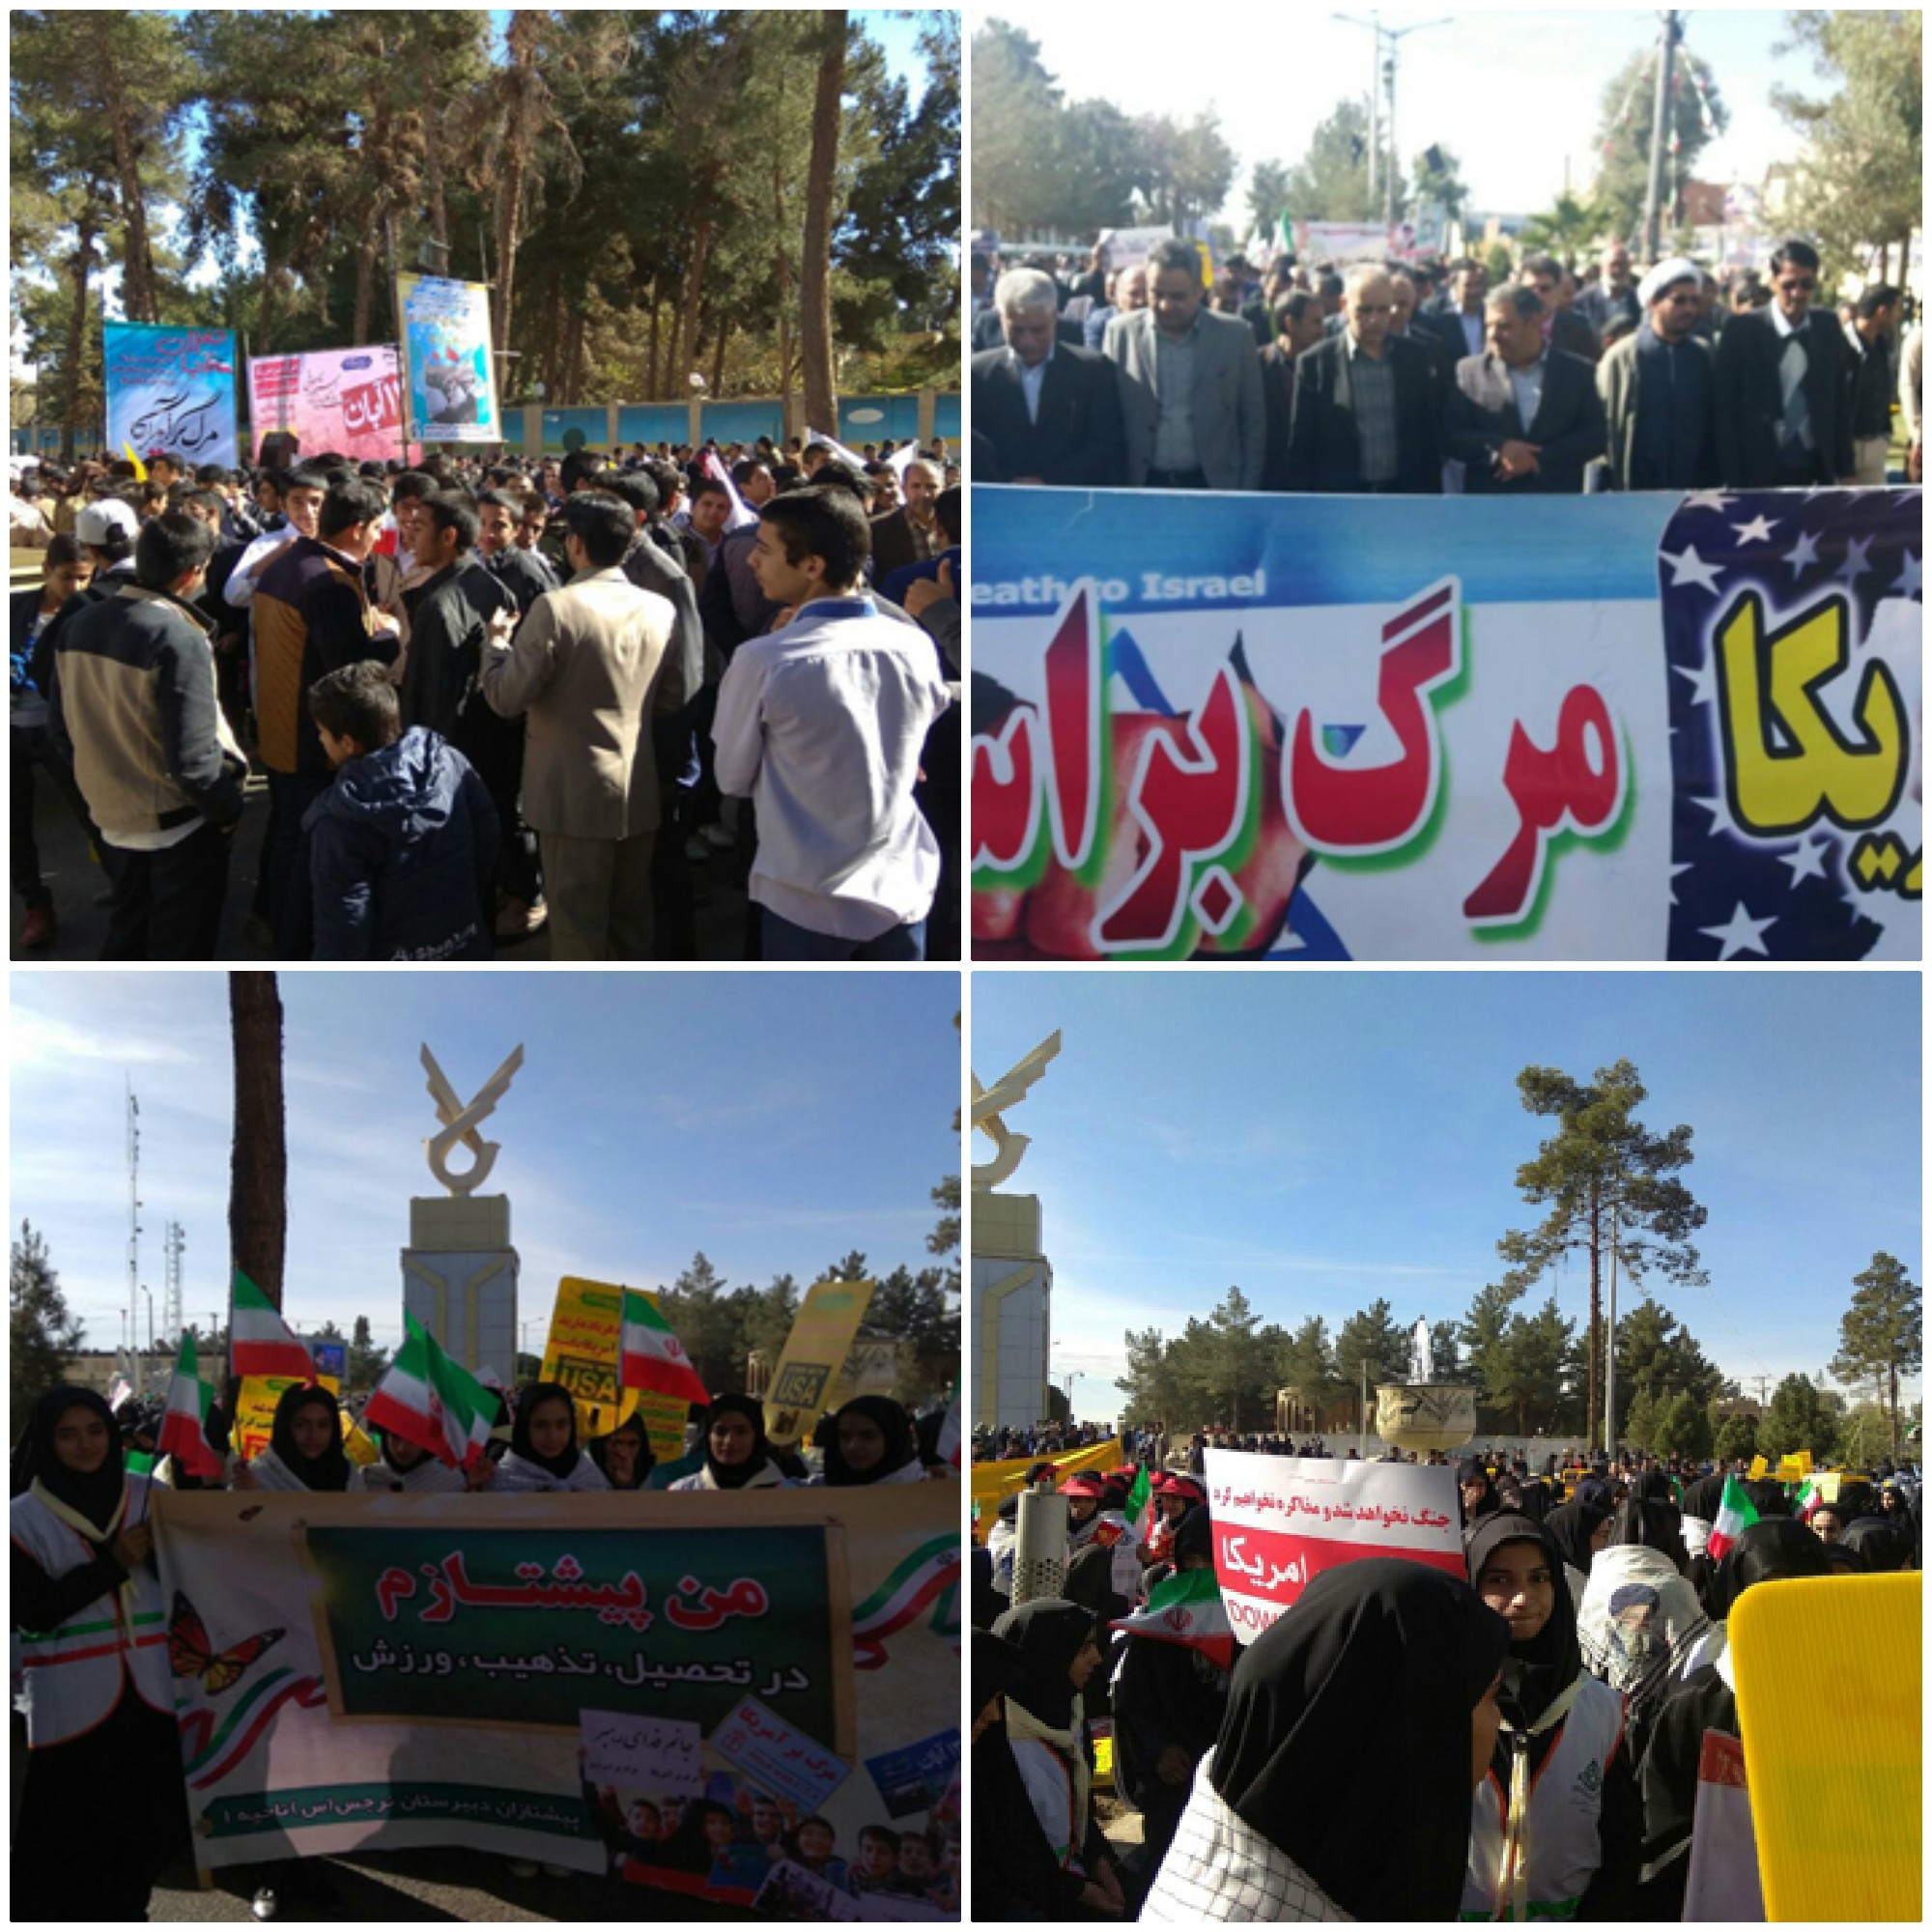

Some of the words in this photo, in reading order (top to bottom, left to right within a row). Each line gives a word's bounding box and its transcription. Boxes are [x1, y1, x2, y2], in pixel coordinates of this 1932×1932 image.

[971, 577, 1065, 606] eath
[1142, 570, 1265, 601] Israel
[1283, 576, 1623, 929] مرگ
[1091, 661, 1250, 947] بر
[558, 1365, 617, 1403] USA
[779, 1375, 816, 1406] USA
[1411, 1508, 1453, 1533] جنگ
[375, 1548, 656, 1633] پیشتازم
[665, 1574, 770, 1631] من
[1228, 1599, 1279, 1631] DOW
[353, 1637, 453, 1676] ورزش
[759, 1663, 810, 1697] در
